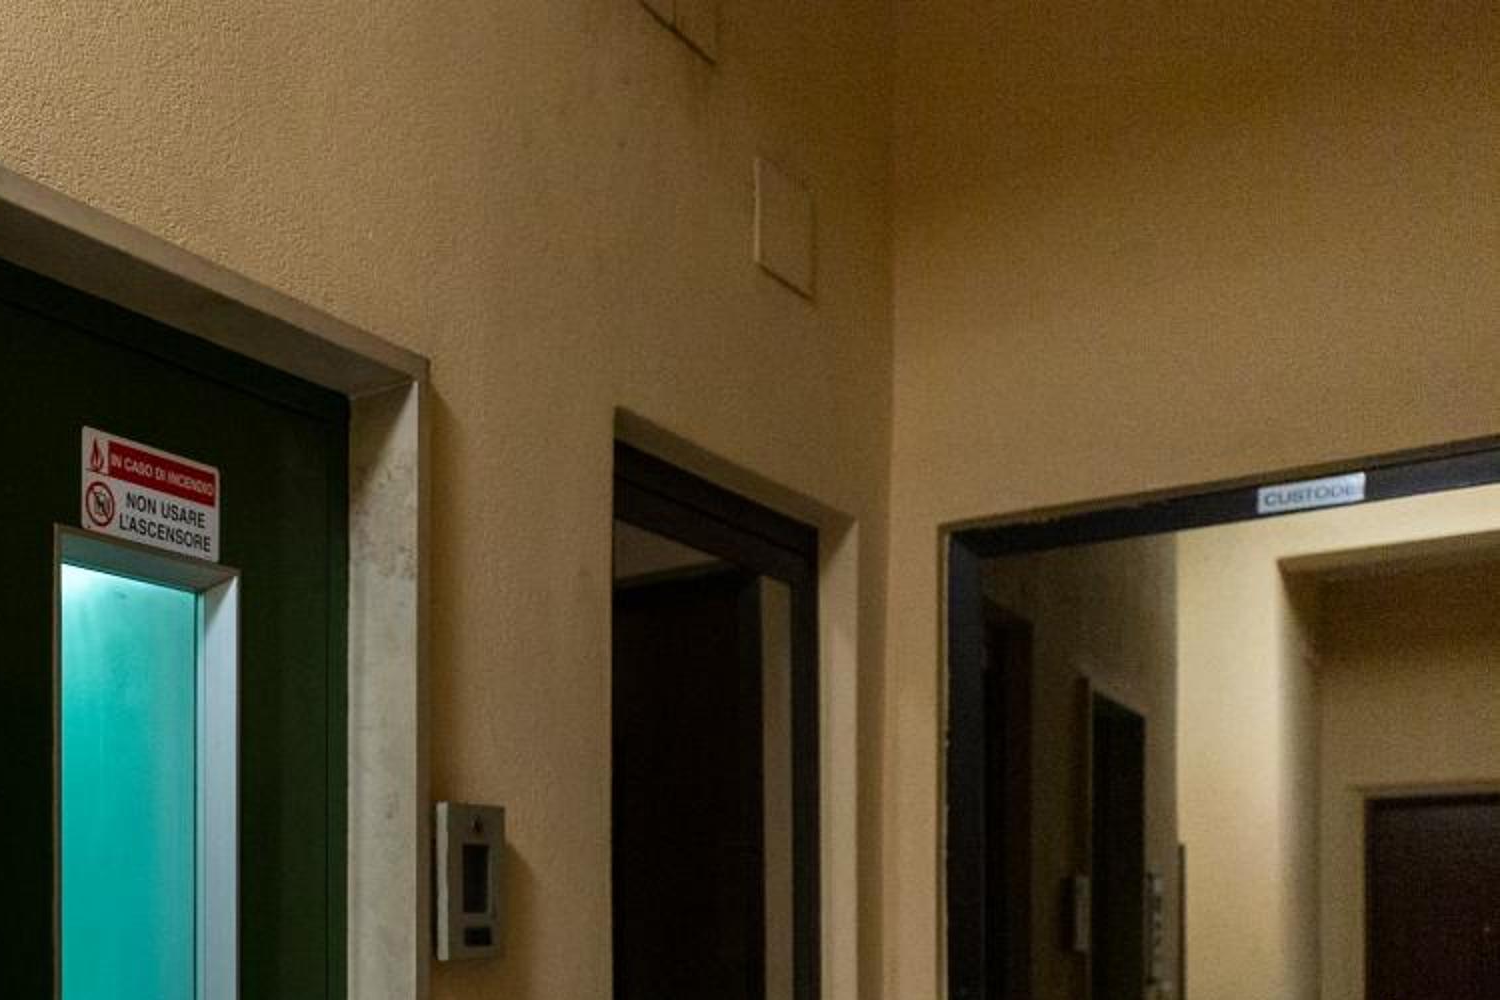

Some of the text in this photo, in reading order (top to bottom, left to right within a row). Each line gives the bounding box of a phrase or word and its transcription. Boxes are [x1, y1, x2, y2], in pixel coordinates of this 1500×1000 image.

[110, 453, 213, 496] IN CASO DI INCENDIO
[126, 492, 206, 529] NON USARE
[119, 512, 211, 552] L'ASCENSORE
